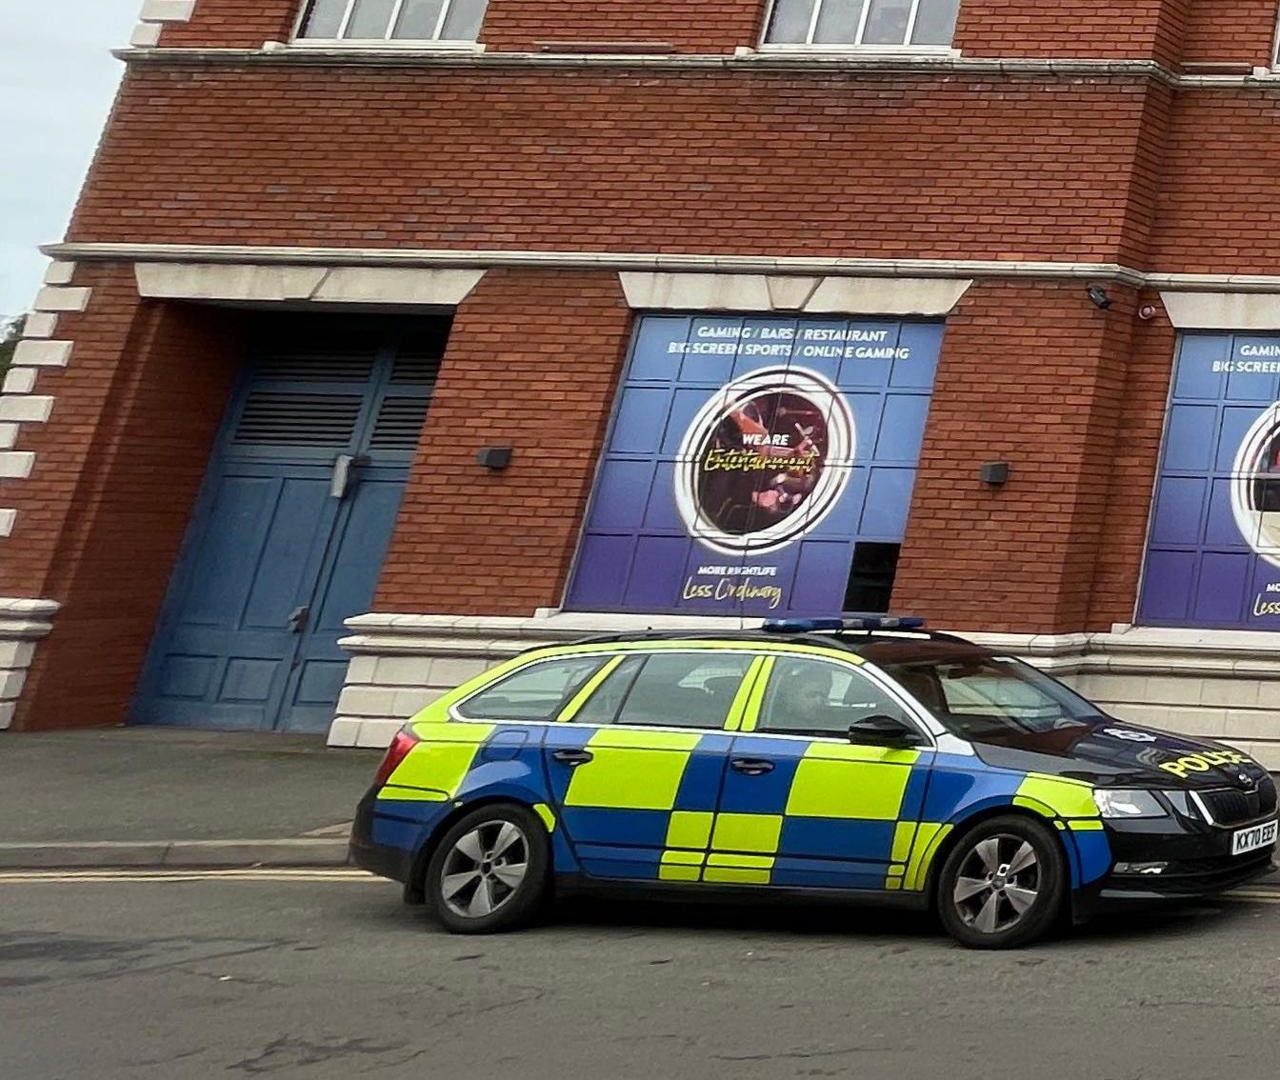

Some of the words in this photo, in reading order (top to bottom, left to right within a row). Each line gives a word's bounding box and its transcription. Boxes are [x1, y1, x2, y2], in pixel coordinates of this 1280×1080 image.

[698, 326, 751, 339] GAMING
[760, 328, 794, 340] BARS
[804, 329, 887, 341] RESTAURANT
[667, 342, 690, 354] BIG
[691, 343, 742, 355] SCREEN
[745, 345, 793, 357] SPORTS
[804, 346, 853, 358] ONLINE
[856, 346, 910, 359] GAMING
[1212, 361, 1234, 372] BIG
[743, 434, 762, 445] WE
[762, 434, 790, 446] ARE
[697, 566, 727, 576] MORE
[683, 577, 712, 601] Less
[1158, 750, 1252, 779] POLICE
[1236, 828, 1261, 850] KX70
